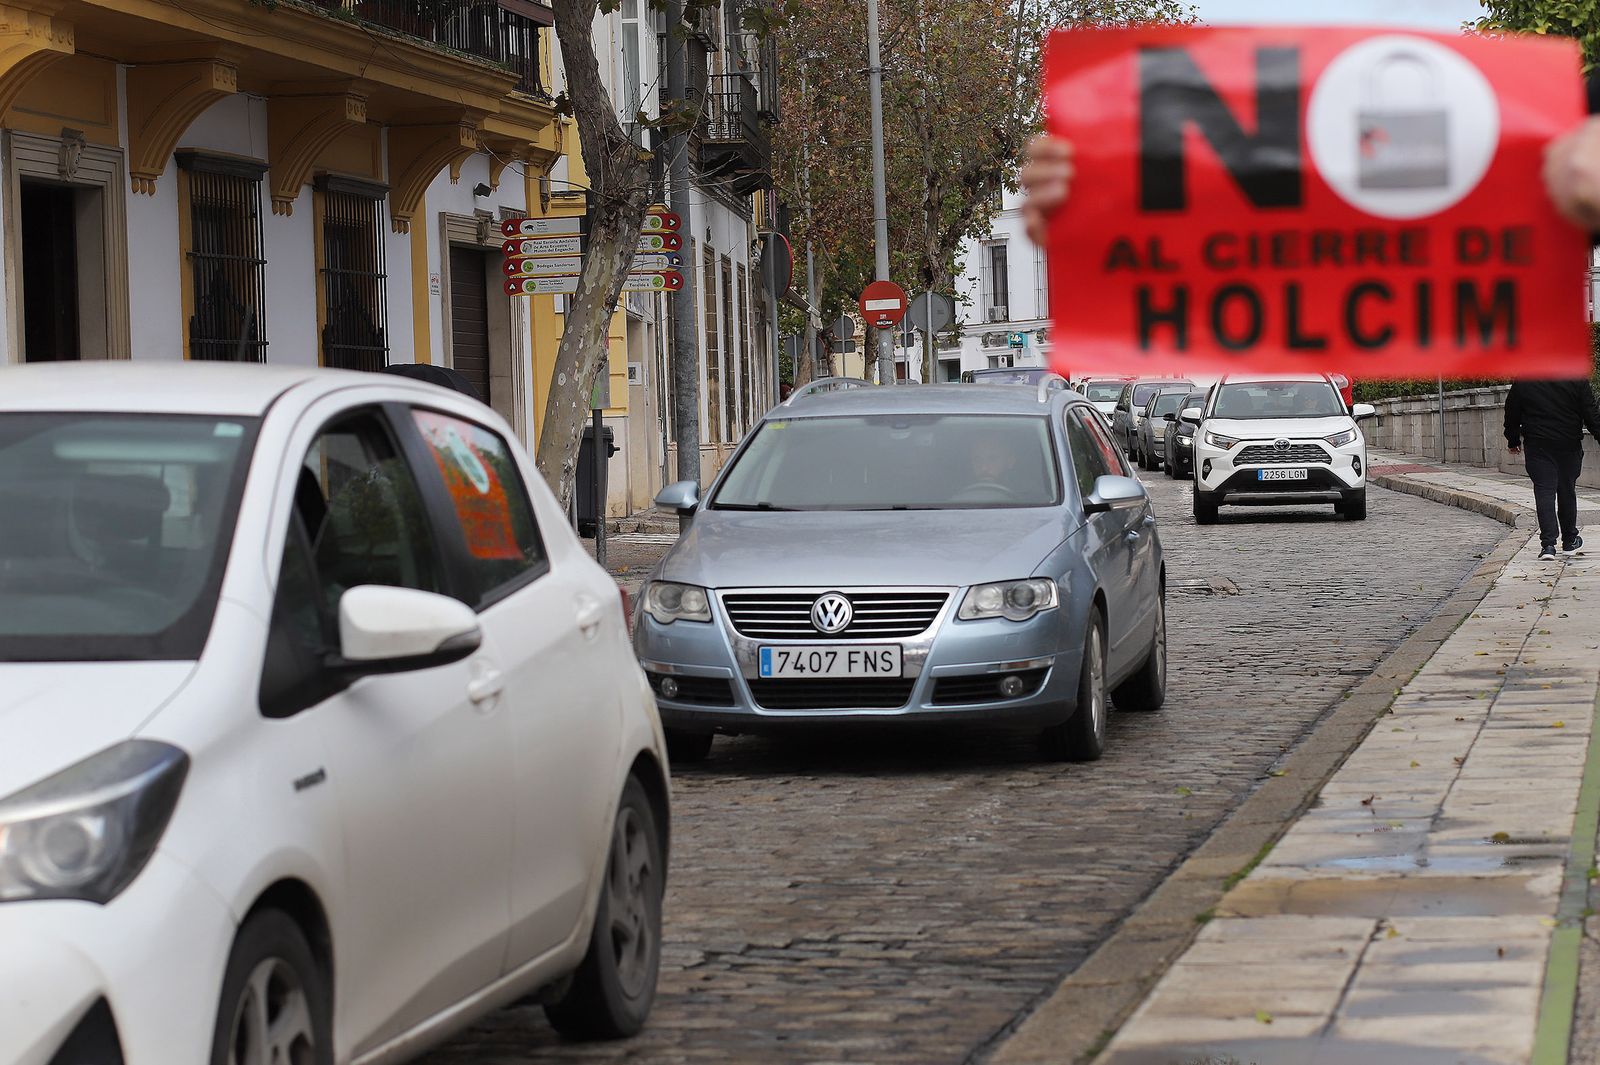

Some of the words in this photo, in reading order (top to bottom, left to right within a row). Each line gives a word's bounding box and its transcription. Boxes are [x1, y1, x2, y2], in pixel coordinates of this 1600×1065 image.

[1104, 235, 1180, 273] AL
[1202, 227, 1428, 269] CIERRE
[1456, 226, 1535, 265] DE
[1135, 278, 1521, 353] HOLCIM
[1264, 470, 1286, 479] 2256
[1288, 470, 1306, 479] LGN
[777, 651, 838, 674] 7407
[847, 651, 894, 673] FNS
